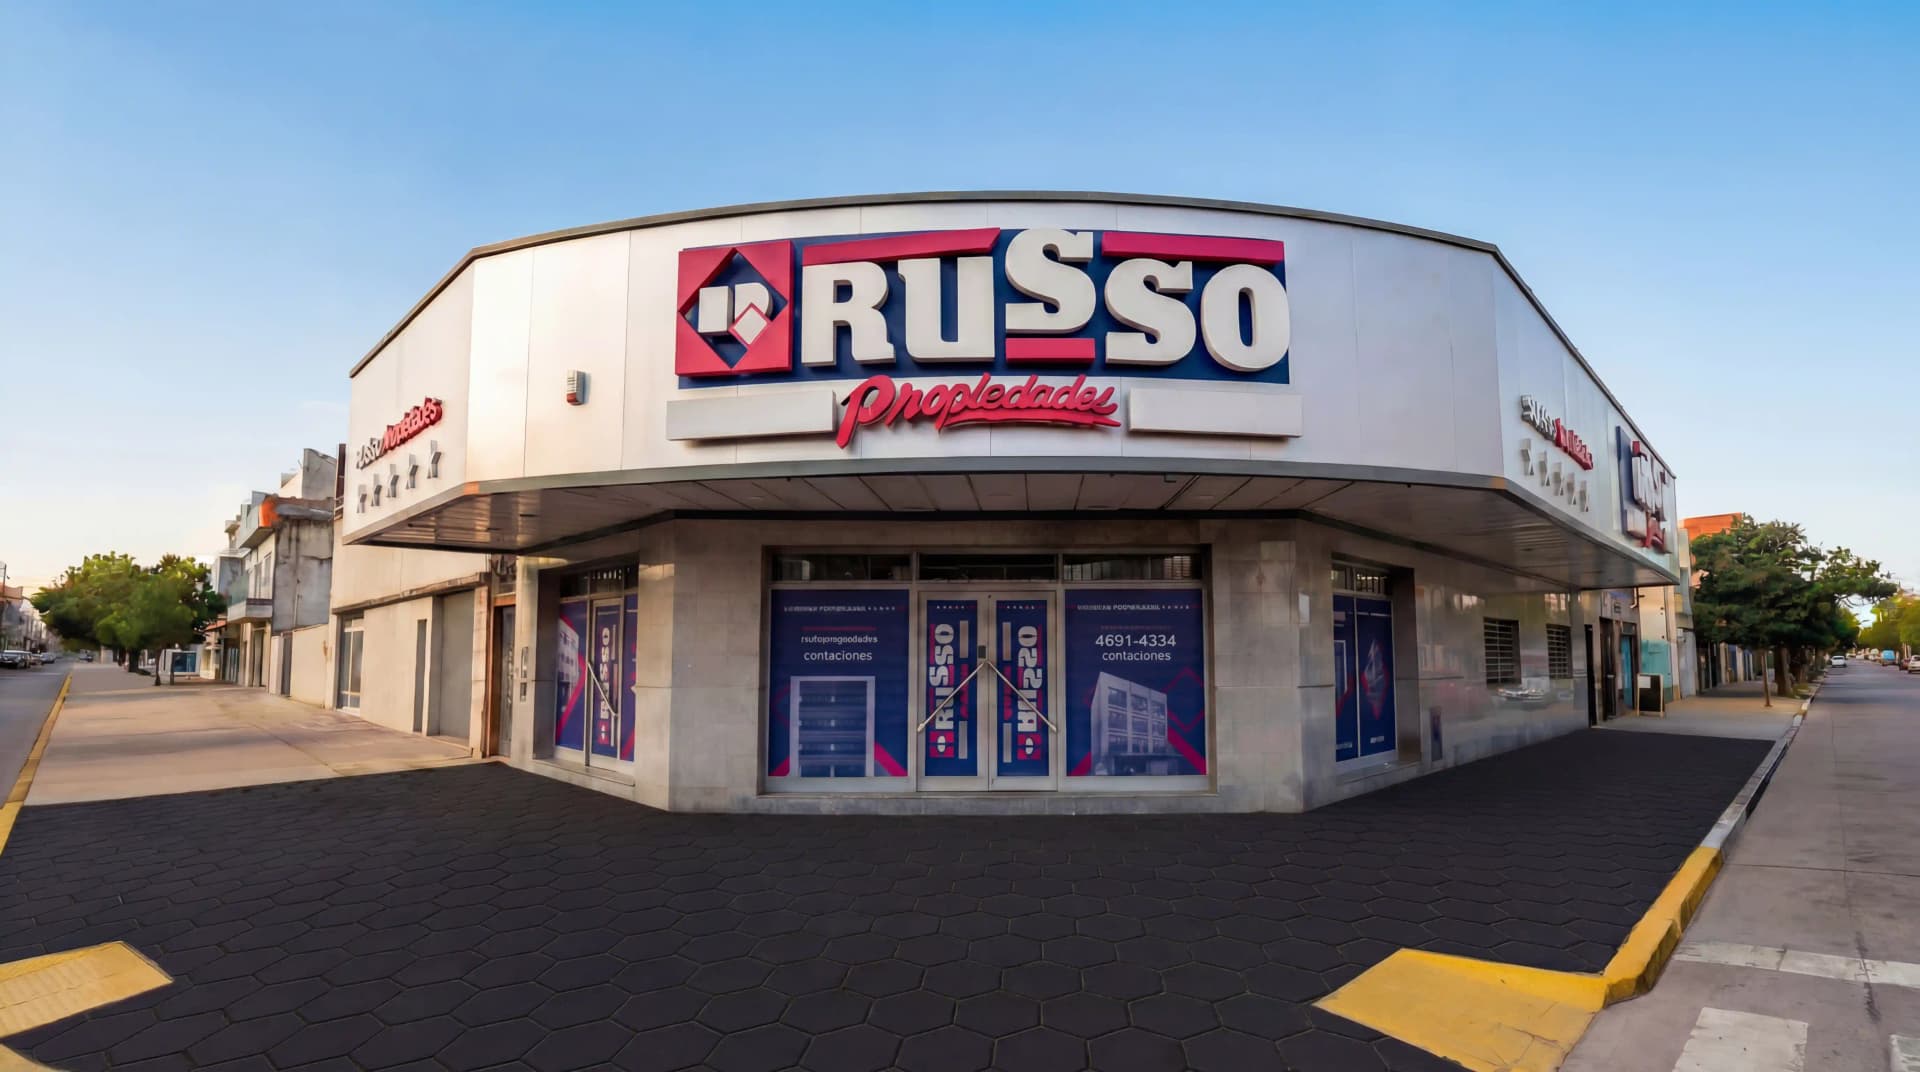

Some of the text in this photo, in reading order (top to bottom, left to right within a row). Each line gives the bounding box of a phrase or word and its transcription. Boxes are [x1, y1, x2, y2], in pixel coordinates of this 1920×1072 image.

[801, 229, 1290, 372] RUSSO
[1095, 634, 1177, 647] 4691-4334
[803, 650, 873, 661] contaciones
[1102, 650, 1172, 661] contaciones
